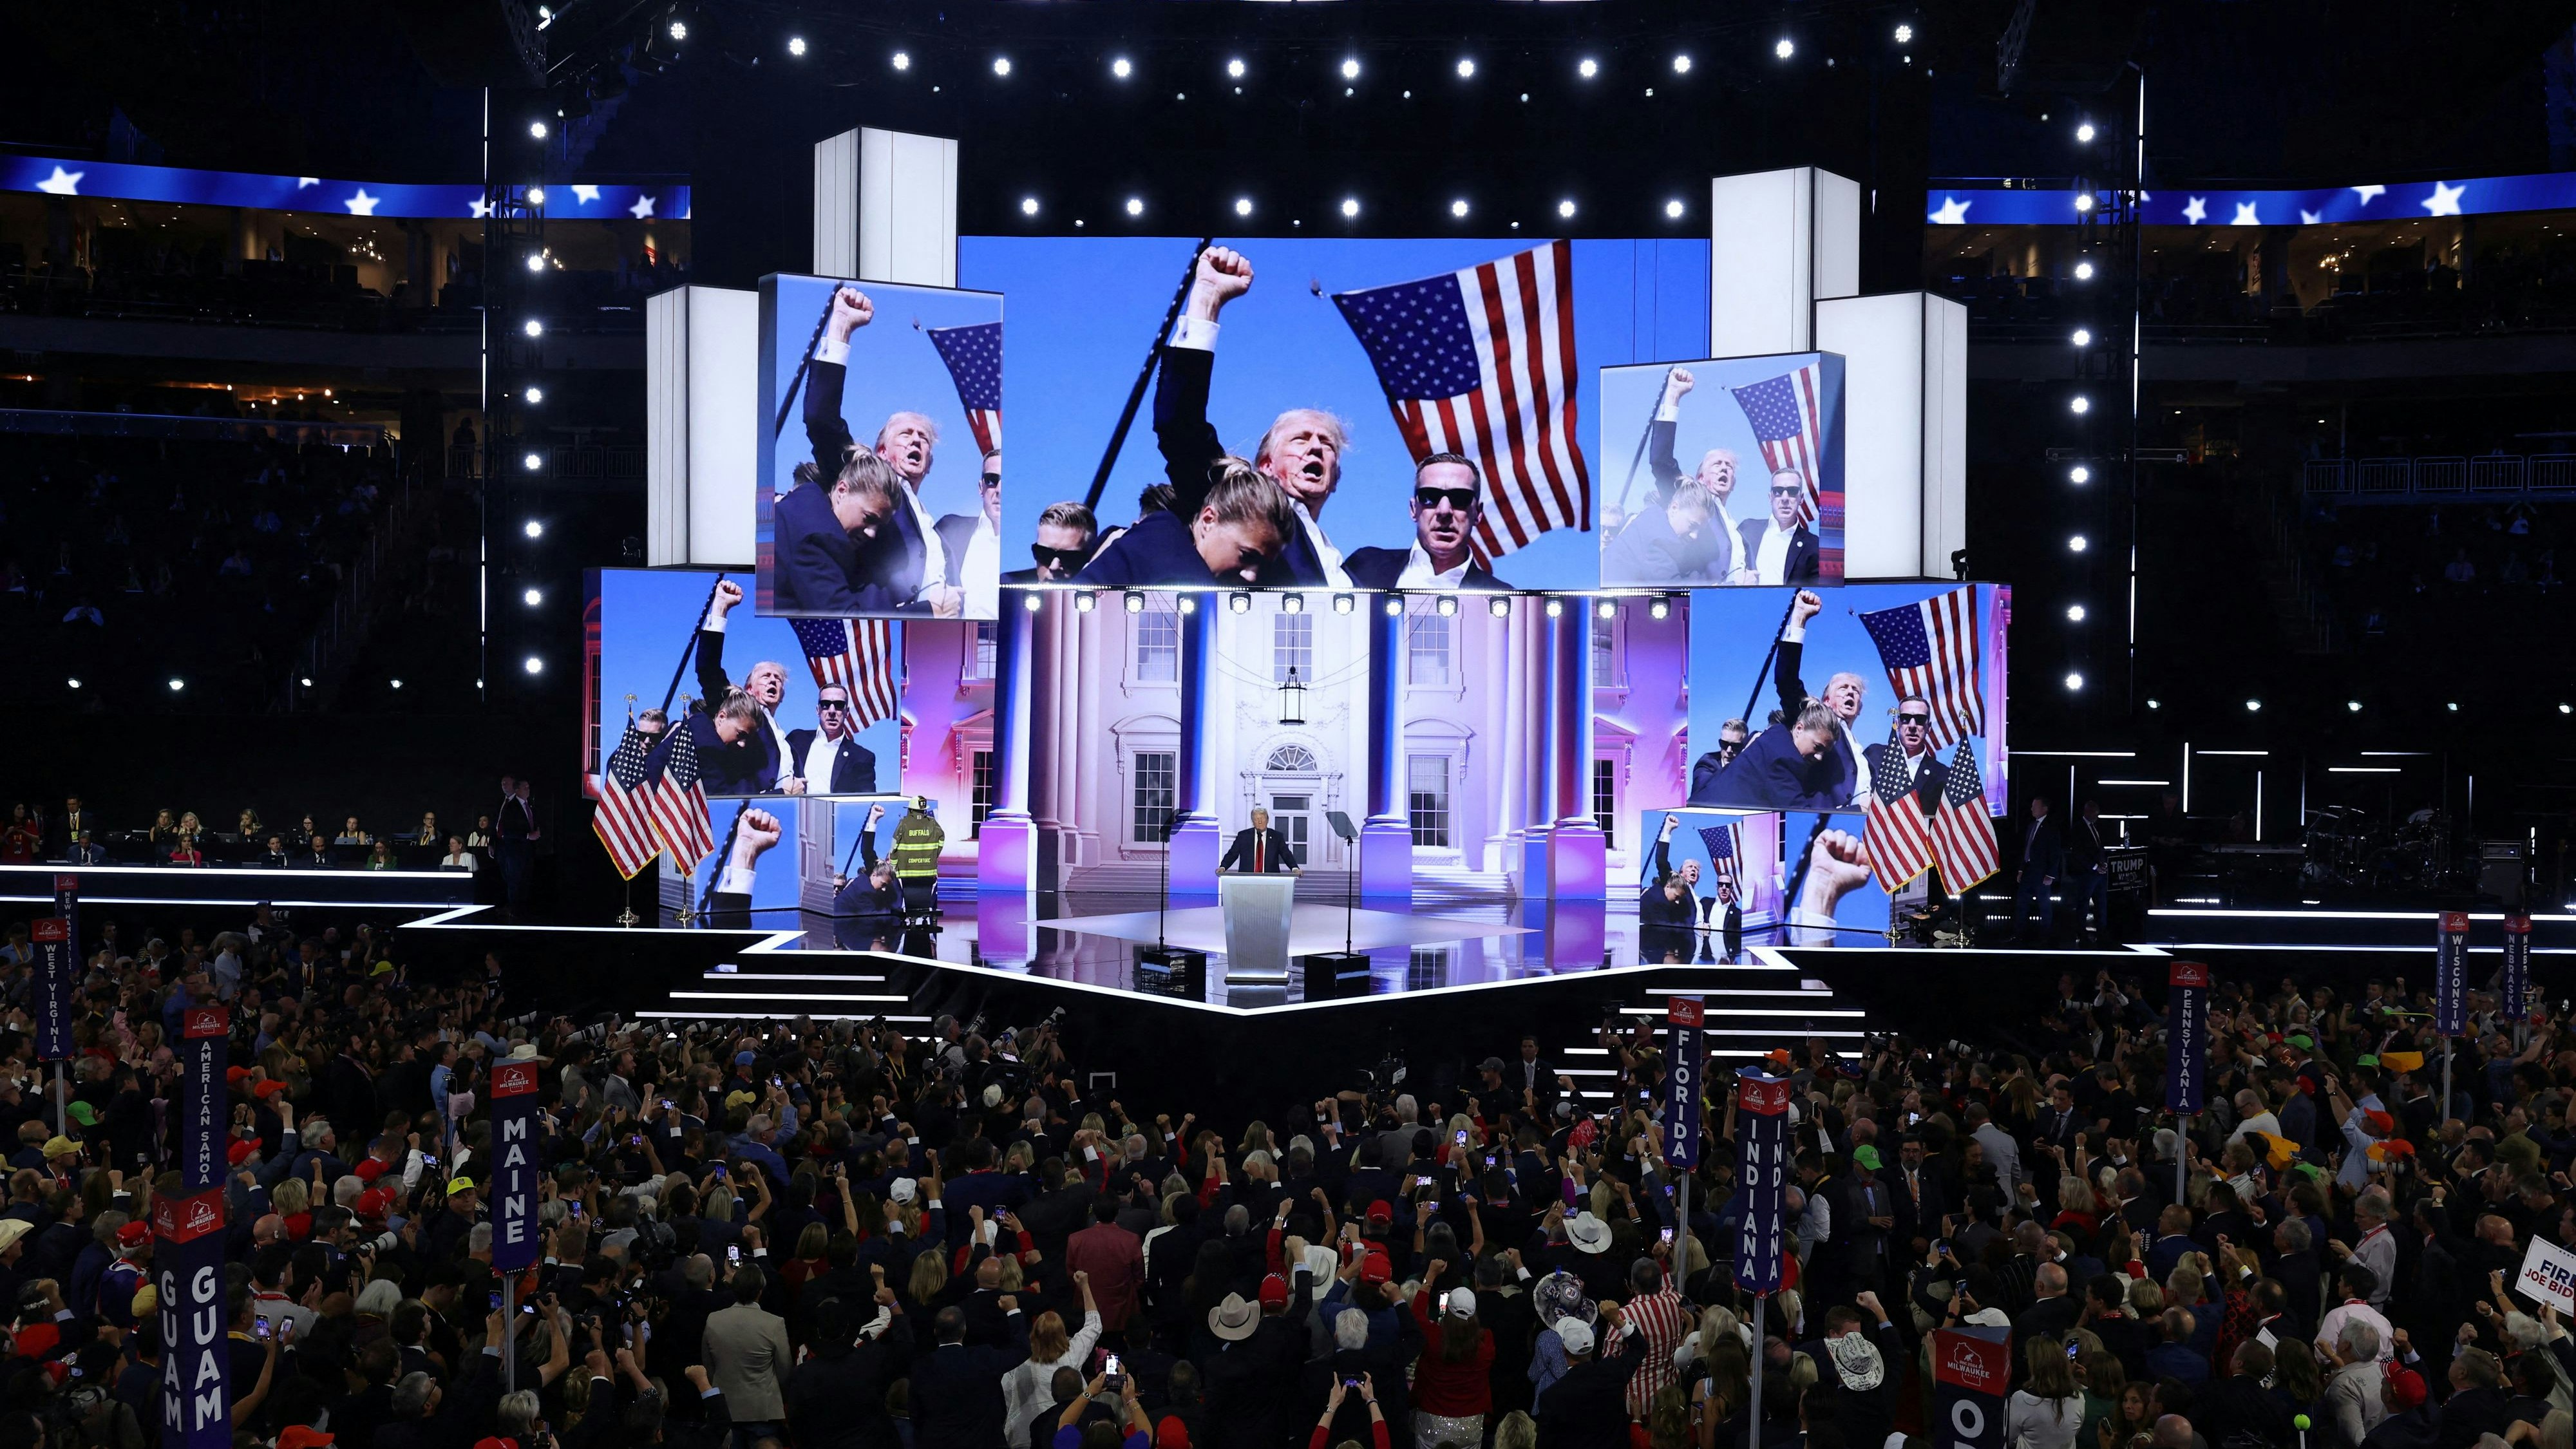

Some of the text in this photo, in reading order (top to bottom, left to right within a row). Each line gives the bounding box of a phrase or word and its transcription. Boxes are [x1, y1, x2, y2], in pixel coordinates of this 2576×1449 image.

[2110, 858, 2144, 873] TRUMP
[44, 944, 60, 1053] WEST VIRGINIA
[2451, 935, 2463, 1030] WISCONSIN
[2507, 934, 2515, 1015] NEBRASKA
[499, 1079, 529, 1088] MILWAUKEE
[1672, 1029, 1690, 1159] FLORIDA
[2179, 989, 2192, 1107] PENNSYLVANIA
[199, 1041, 212, 1184] AMERICAN SAMOA
[187, 1213, 216, 1229] MILWAUKEE
[504, 1117, 526, 1244] MAINE
[1741, 1119, 1760, 1281] INDIANA
[1769, 1120, 1786, 1282] INDIANA
[2524, 1268, 2547, 1287] JOE
[161, 1270, 182, 1434] GUAM
[191, 1265, 222, 1432] GUAM
[1947, 1360, 1990, 1379] MILWAUKEE
